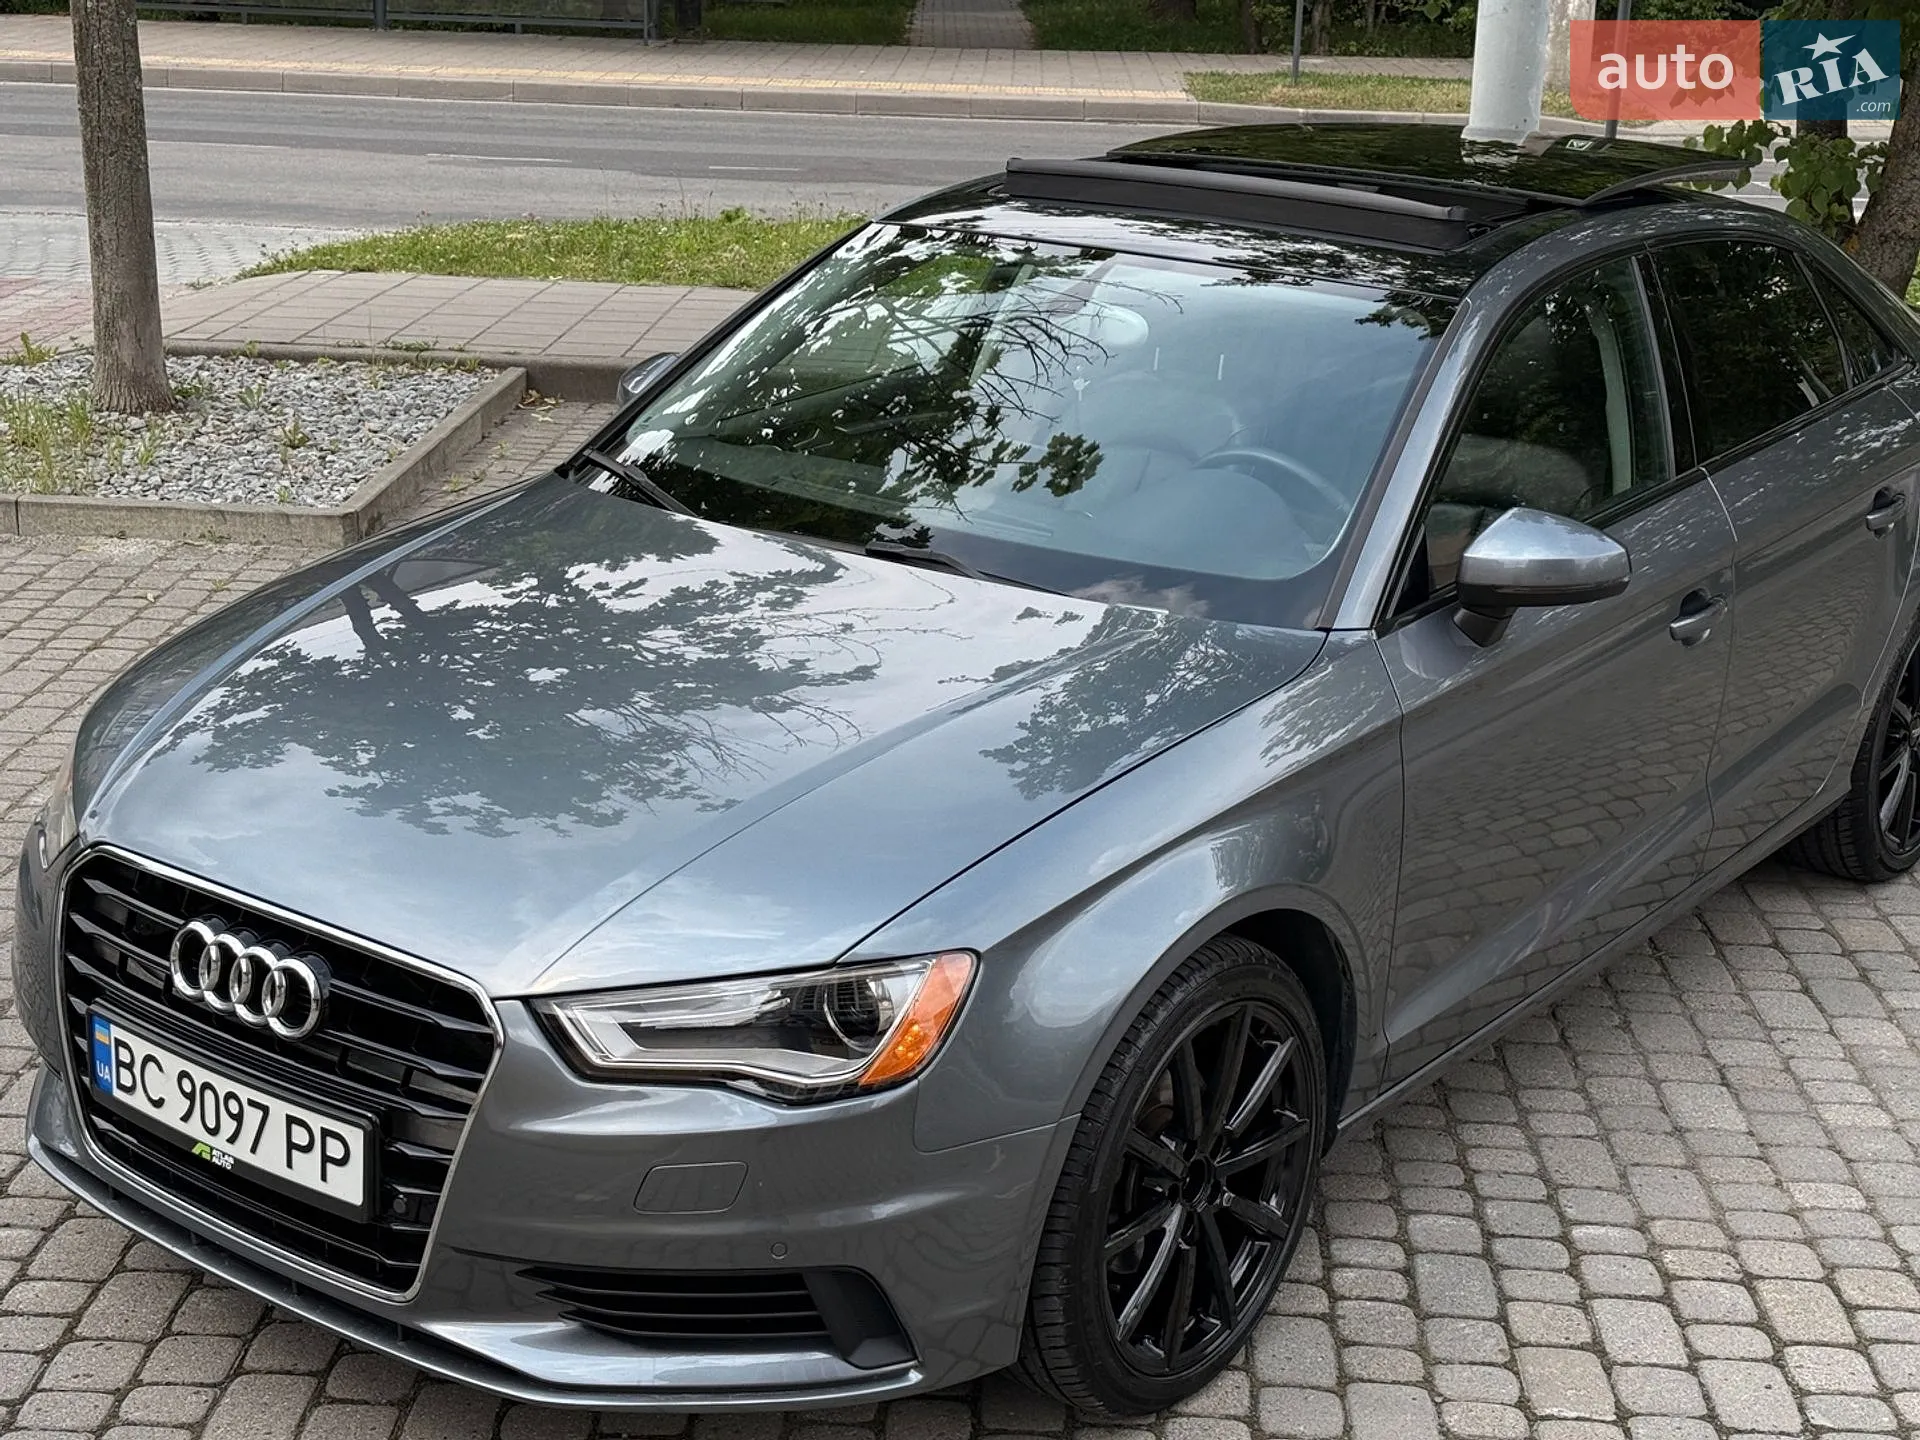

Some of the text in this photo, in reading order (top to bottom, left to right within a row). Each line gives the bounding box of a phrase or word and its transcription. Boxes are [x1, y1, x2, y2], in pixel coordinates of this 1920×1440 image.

[96, 1060, 111, 1082] UA
[115, 1036, 350, 1183] BC 9097 PP
[212, 1156, 232, 1170] AUTO
